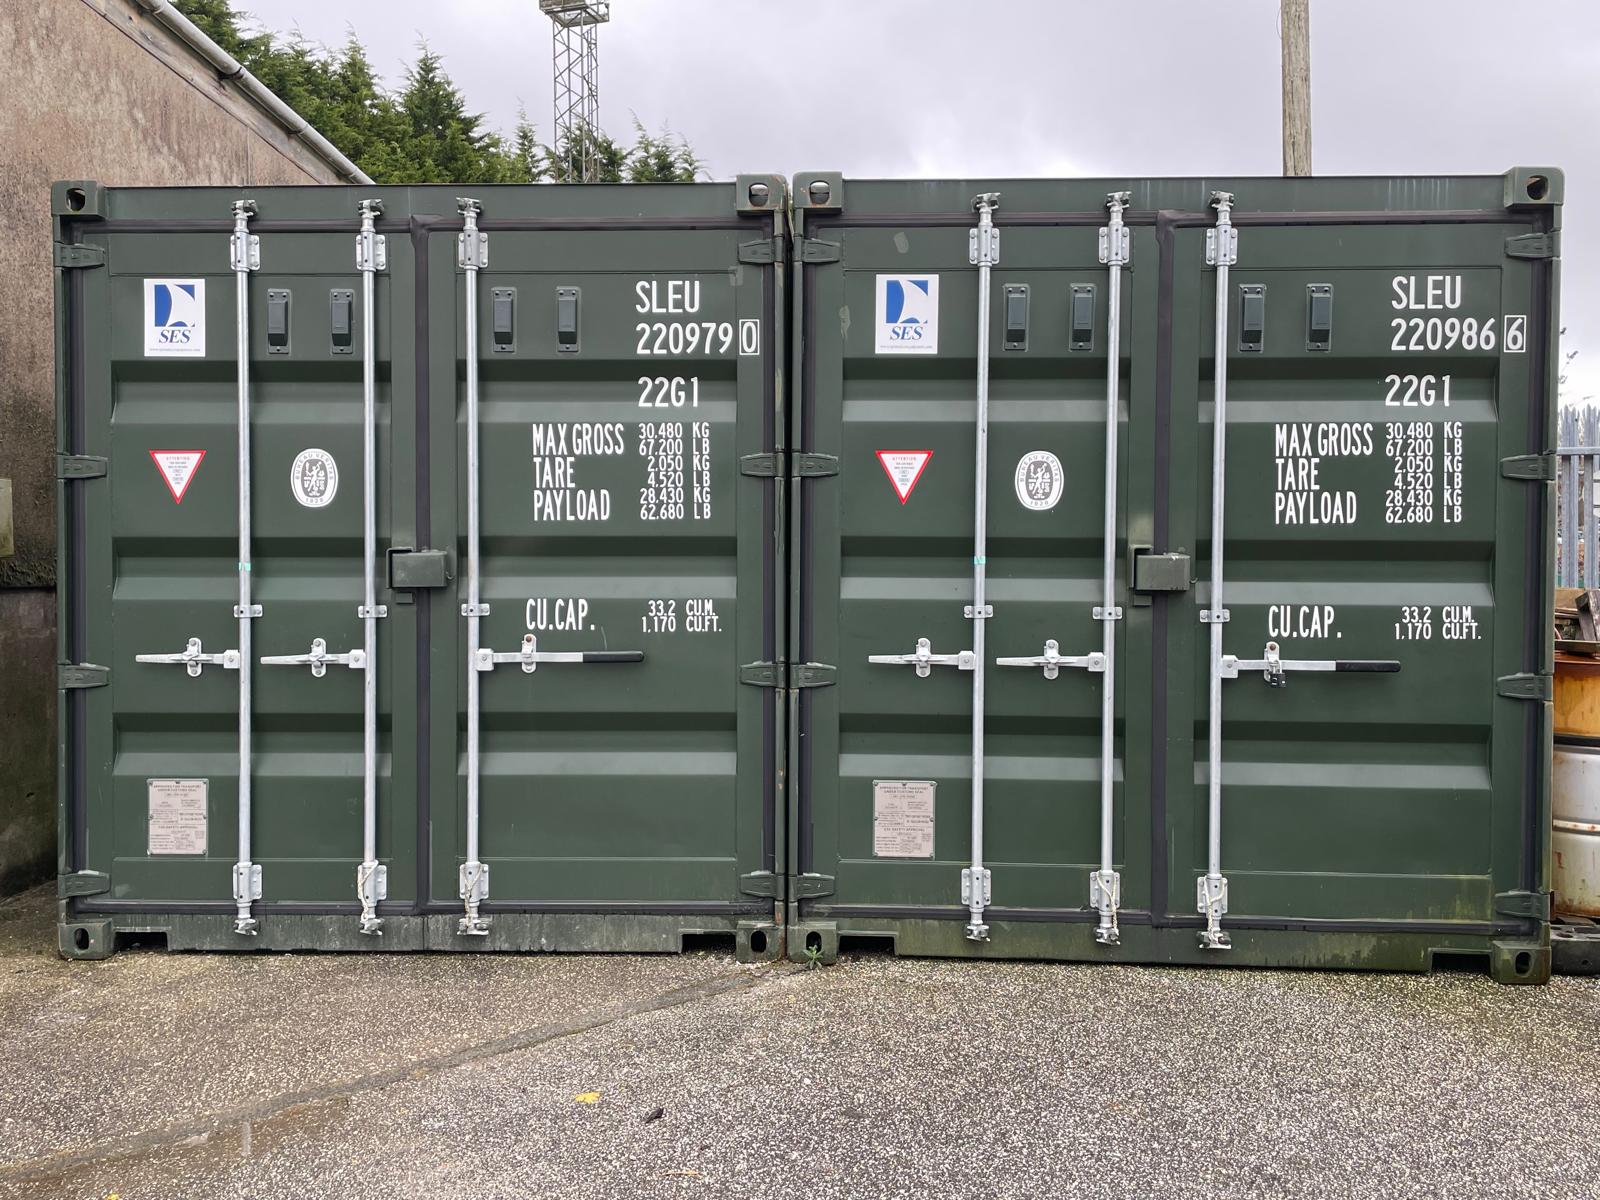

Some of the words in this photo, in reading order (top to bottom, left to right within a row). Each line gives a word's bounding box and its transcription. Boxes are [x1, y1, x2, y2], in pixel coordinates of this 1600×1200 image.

[636, 281, 699, 313] SLEU
[1392, 276, 1461, 309] SLEU
[159, 329, 191, 344] SES
[636, 323, 732, 354] 220979
[743, 322, 756, 352] 0
[890, 326, 923, 341] SES
[1392, 318, 1495, 350] 220986
[1506, 317, 1522, 349] 6
[638, 377, 698, 407] 22G1
[1385, 375, 1449, 406] 22G1
[533, 424, 567, 455] MAX
[573, 423, 624, 455] GROSS
[639, 423, 683, 439] 30,480
[692, 422, 709, 438] KG
[1386, 422, 1433, 439] 30,480
[1444, 422, 1462, 438] KG
[639, 439, 683, 455] 67,200
[693, 438, 709, 454] LB
[1276, 424, 1312, 456] MAX
[1318, 423, 1373, 455] GROSS
[1386, 439, 1433, 456] 67,200
[1444, 439, 1462, 455] LB
[648, 455, 683, 471] 2,050
[693, 455, 710, 471] KG
[1020, 455, 1038, 482] BUREAU
[1041, 455, 1059, 482] VERITAS
[1395, 456, 1433, 473] 2,050
[1444, 456, 1462, 472] KG
[534, 457, 575, 488] TARE
[648, 471, 683, 487] 4,520
[694, 471, 710, 486] LB
[1276, 458, 1319, 490] TARE
[1394, 473, 1433, 489] 4,520
[1444, 472, 1462, 488] LB
[640, 488, 683, 504] 28,430
[694, 487, 710, 503] KG
[1386, 490, 1433, 506] 28,430
[1444, 489, 1462, 506] KG
[534, 489, 610, 520] PAYLOAD
[640, 504, 684, 519] 62,680
[694, 503, 711, 519] LB
[1276, 492, 1356, 524] PAYLOAD
[1385, 506, 1432, 523] 62,680
[1444, 506, 1462, 523] LB
[526, 599, 594, 630] CU.CAP.
[648, 600, 675, 616] 33.2
[686, 599, 715, 615] CU.M.
[1402, 606, 1431, 623] 33.2
[1442, 606, 1474, 622] CU.M.
[642, 616, 676, 633] 1,170
[686, 616, 722, 632] CU.FT.
[1269, 606, 1341, 637] CU.CAP.
[1395, 623, 1432, 640] 1,170
[1442, 623, 1481, 639] CU.FT.
